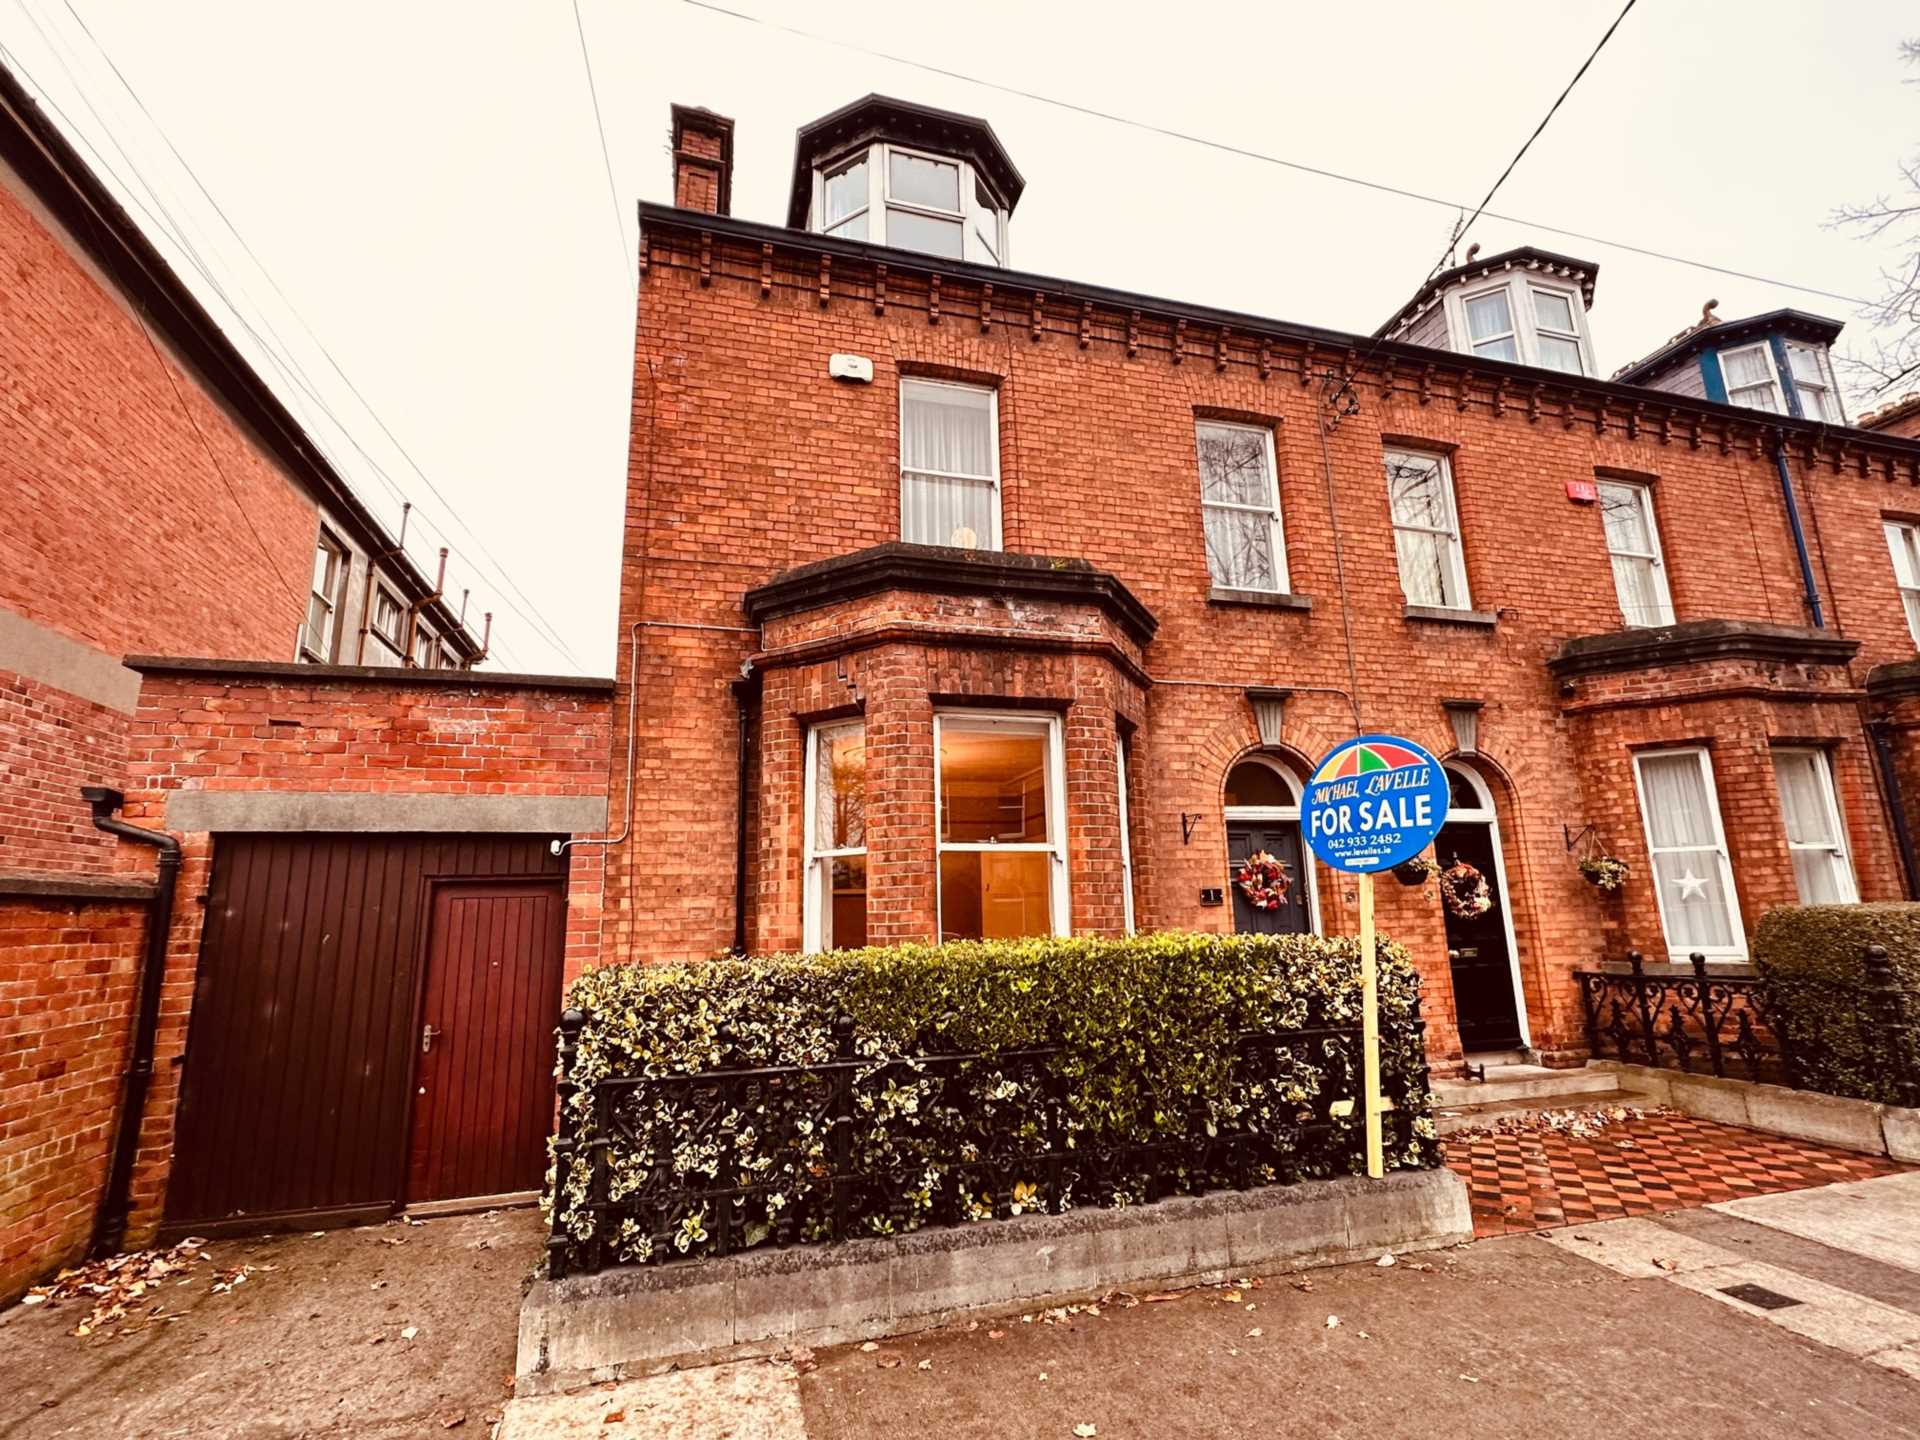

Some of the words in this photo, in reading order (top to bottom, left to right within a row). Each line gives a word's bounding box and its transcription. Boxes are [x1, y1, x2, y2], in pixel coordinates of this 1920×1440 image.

[1312, 780, 1360, 805] MICHAEL
[1365, 768, 1430, 796] LAVELLE
[1311, 805, 1353, 837] FOR
[1360, 795, 1432, 832] SALE
[1328, 839, 1345, 849] 042
[1347, 836, 1367, 847] 933
[1371, 833, 1402, 844] 2482
